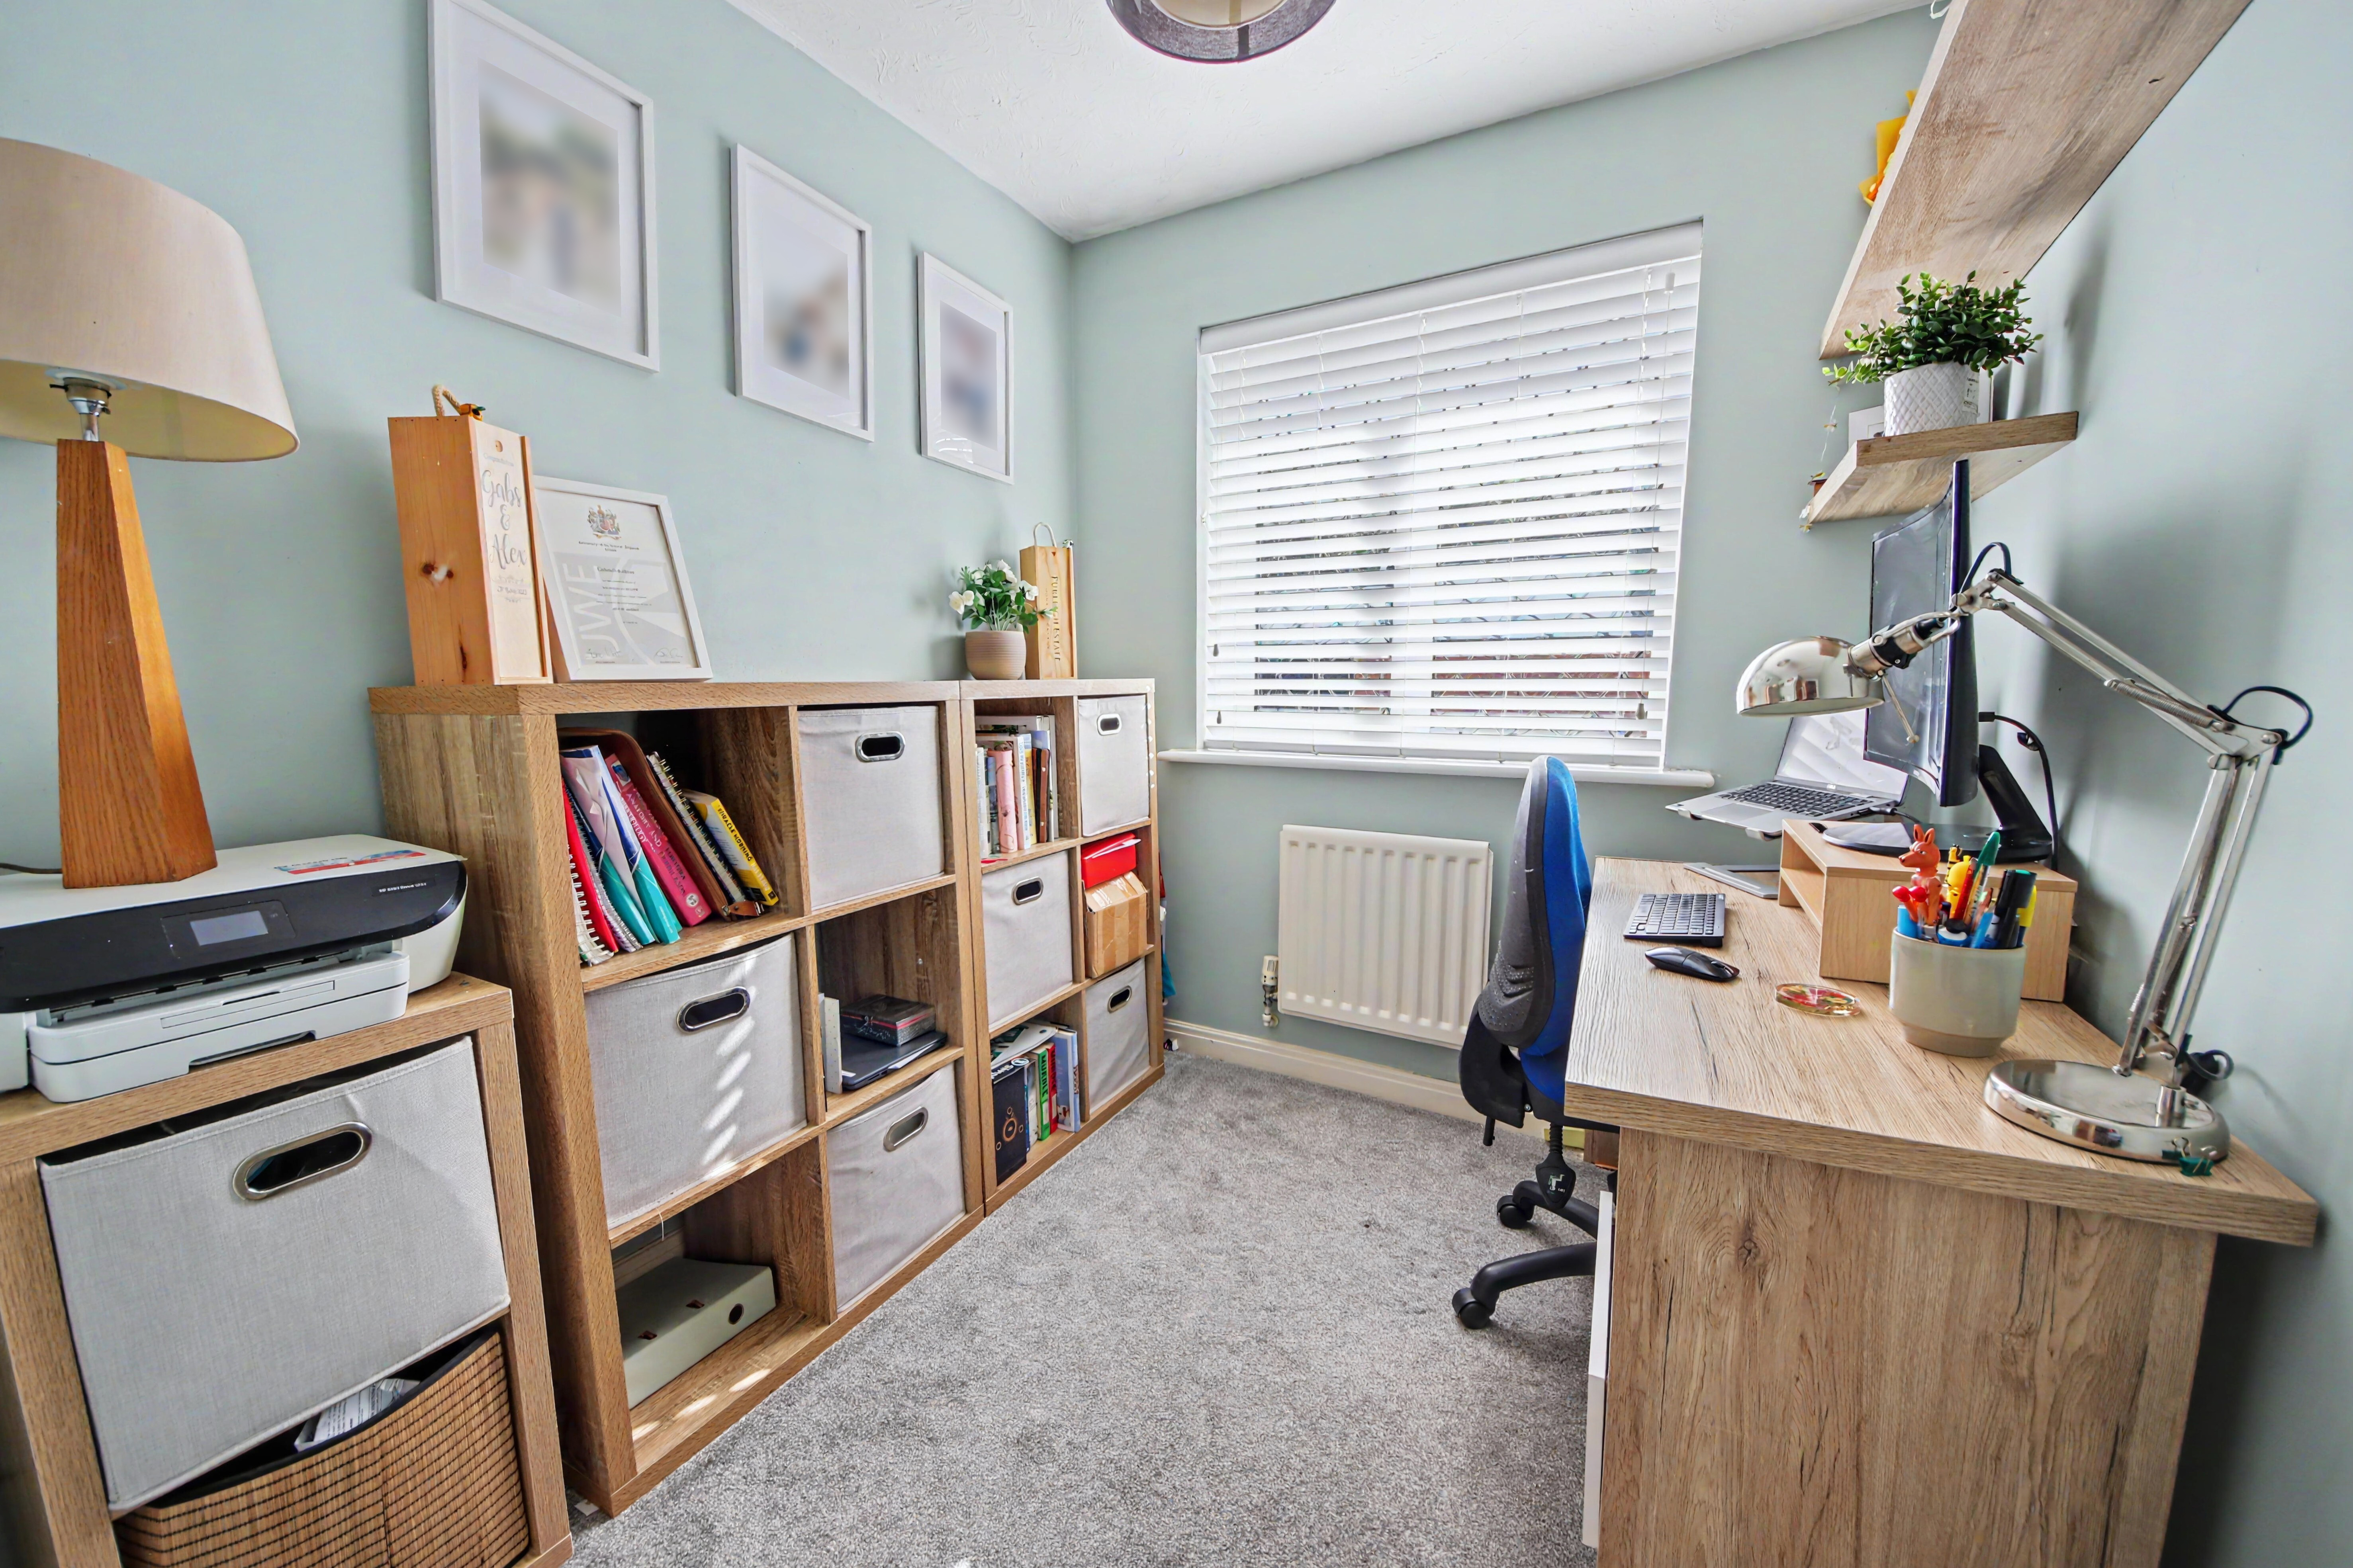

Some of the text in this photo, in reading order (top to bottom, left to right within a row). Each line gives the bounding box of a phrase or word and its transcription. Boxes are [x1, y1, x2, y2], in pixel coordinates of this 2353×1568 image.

[482, 470, 521, 508] Gabs
[500, 504, 510, 530] &
[489, 534, 527, 570] Alex
[649, 830, 662, 847] AND
